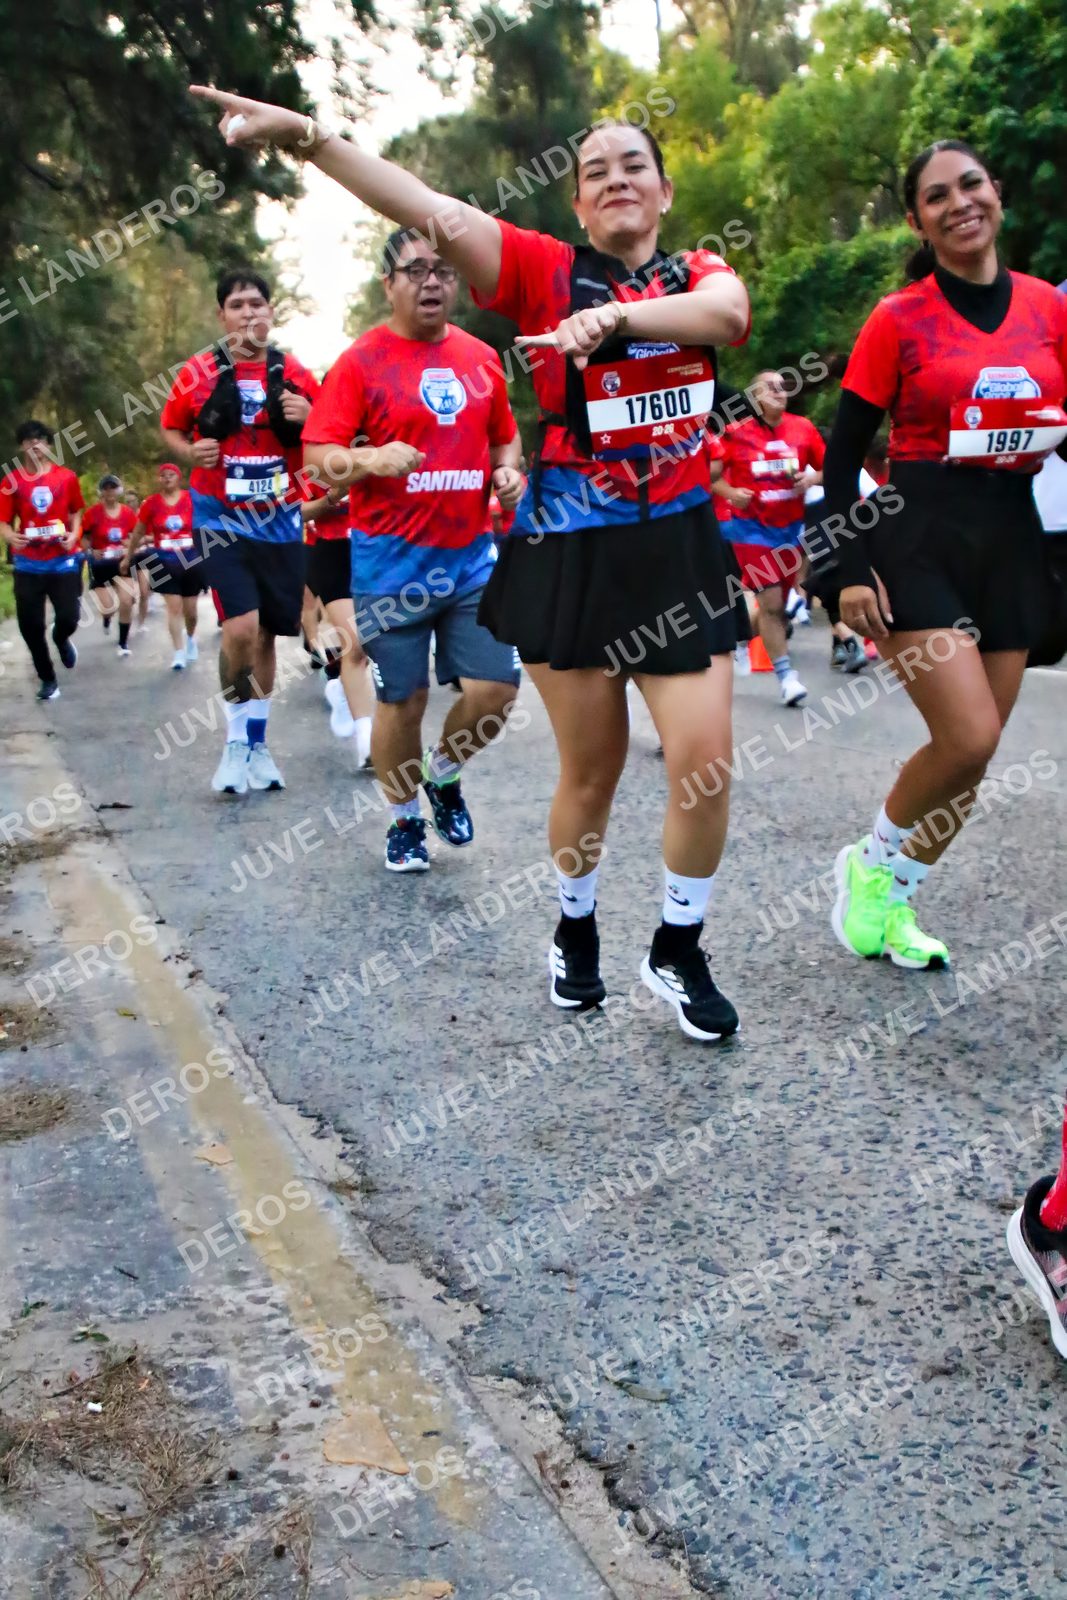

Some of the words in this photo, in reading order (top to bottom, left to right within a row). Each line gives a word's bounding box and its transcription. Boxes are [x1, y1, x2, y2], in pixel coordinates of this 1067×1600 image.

[625, 387, 692, 425] 17600
[986, 429, 1034, 453] 1997
[248, 479, 273, 493] 4124
